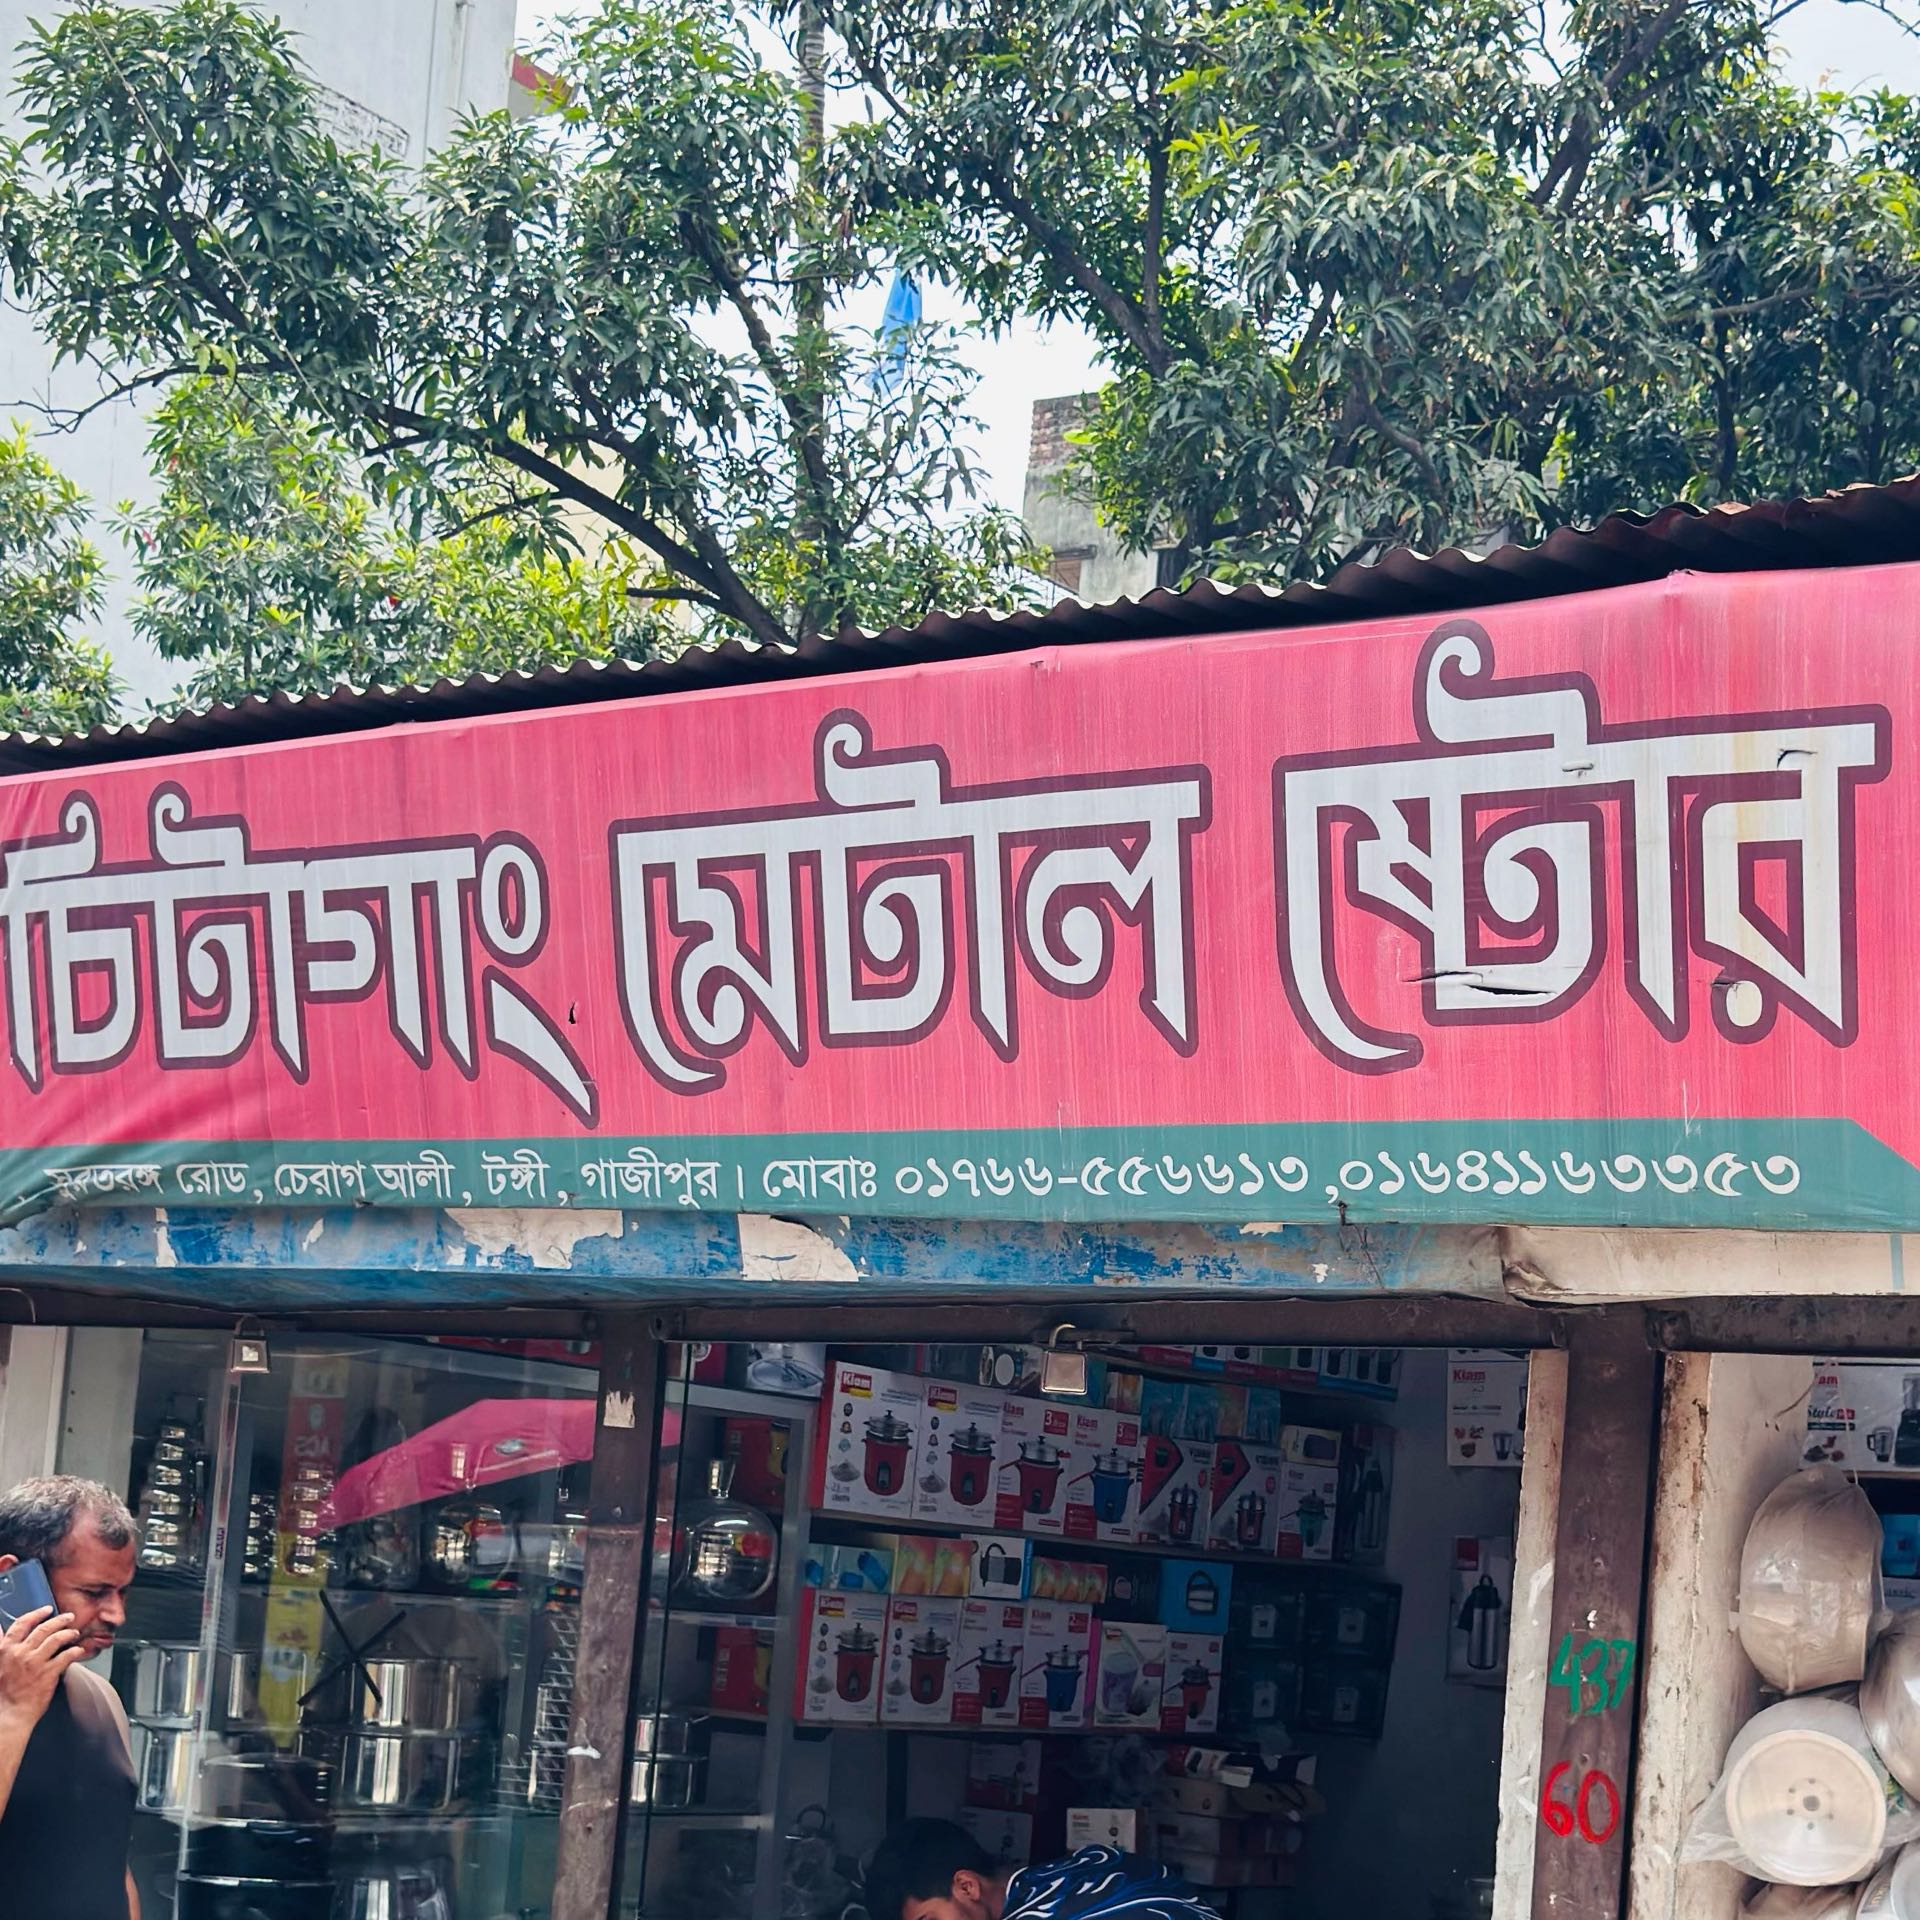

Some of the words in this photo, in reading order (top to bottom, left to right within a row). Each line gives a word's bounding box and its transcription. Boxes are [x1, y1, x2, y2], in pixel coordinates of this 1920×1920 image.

[608, 708, 1211, 1096] মেটাল
[1272, 619, 1892, 1075] ষ্টোর
[274, 1160, 366, 1198] চেরাগ
[580, 1146, 721, 1209] গাজীপুর
[762, 1155, 877, 1200] মোবাঃ
[895, 1152, 1309, 1198] ০১৭৬৬-৫৫৬৬১৩
[1550, 1632, 1635, 1715] 437
[1541, 1760, 1620, 1844] 60
